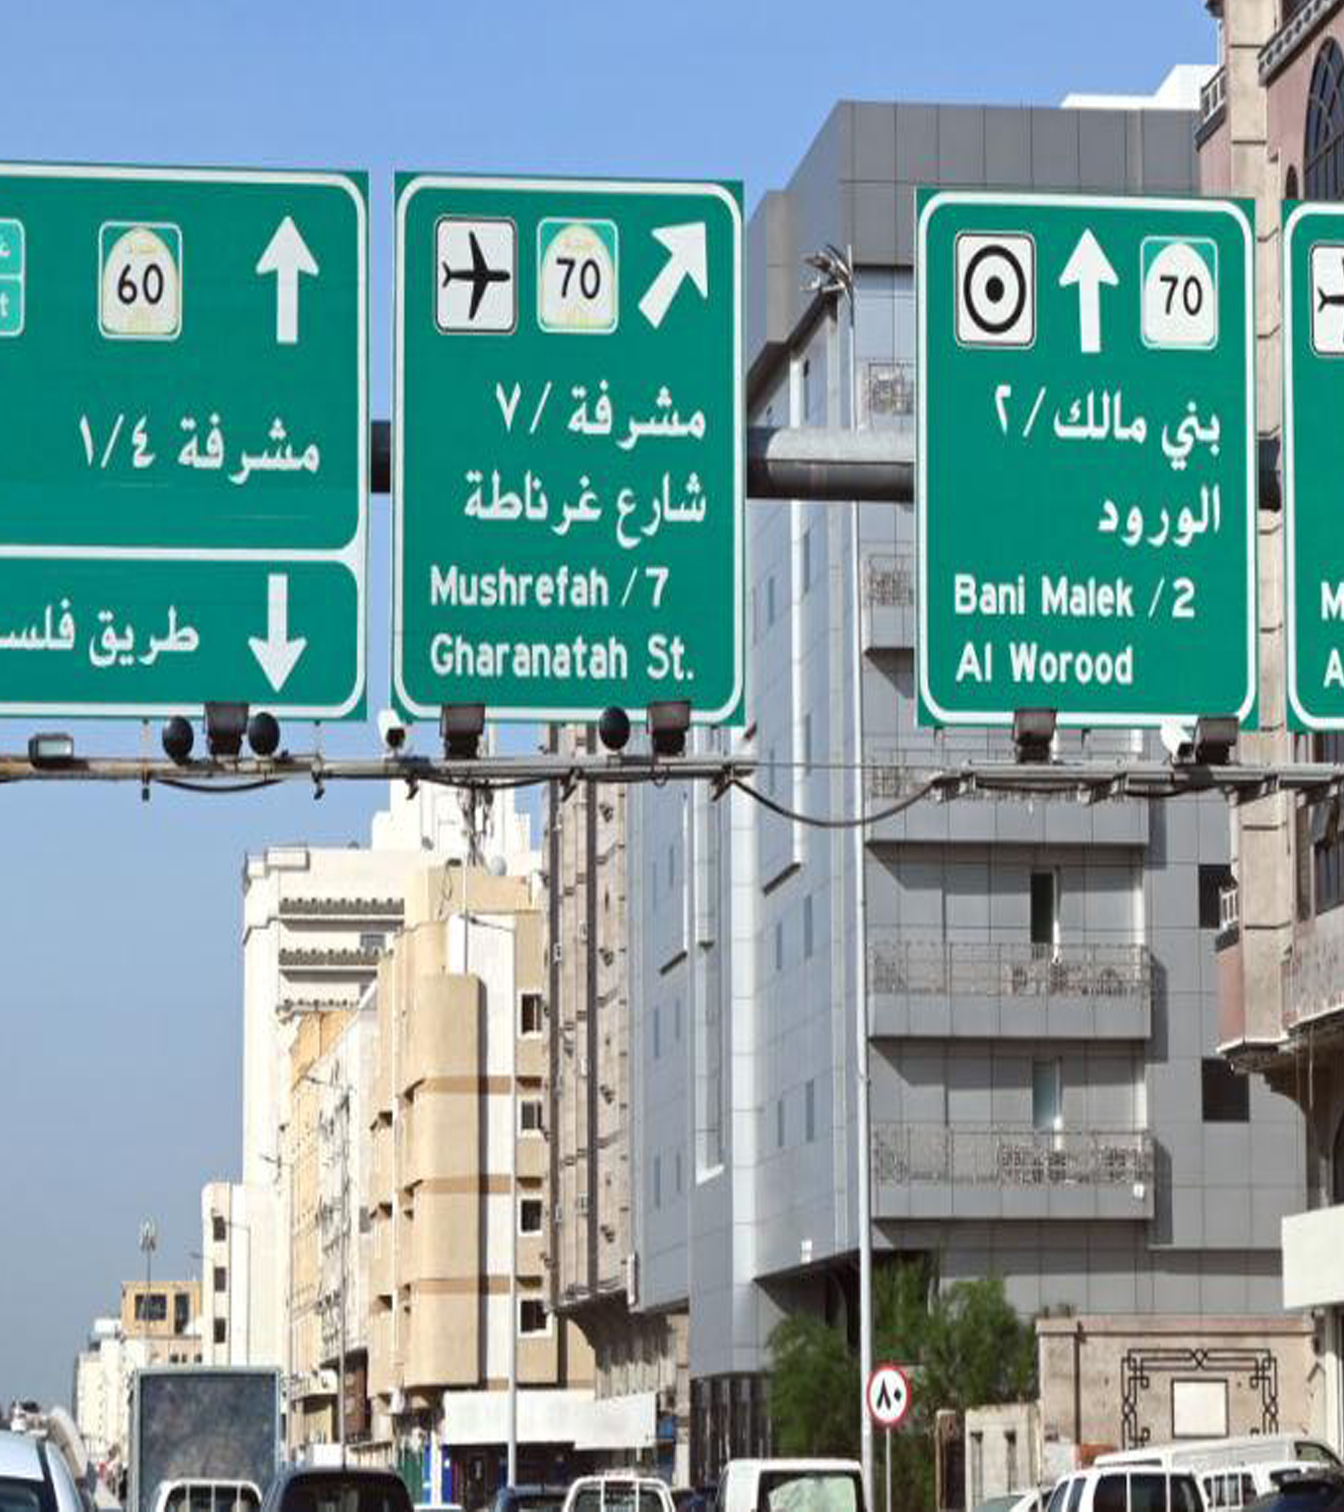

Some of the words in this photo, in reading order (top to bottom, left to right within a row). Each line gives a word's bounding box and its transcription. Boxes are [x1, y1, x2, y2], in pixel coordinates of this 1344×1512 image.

[117, 263, 164, 305] 60
[556, 257, 601, 300] 70
[1159, 275, 1203, 316] 70
[568, 379, 706, 450] مشرفة
[1053, 390, 1148, 443] مالك
[1161, 402, 1221, 471] بني
[178, 413, 320, 484] مشرفة
[464, 469, 602, 535] غرناطة
[616, 472, 706, 549] شارع
[1098, 485, 1221, 547] الورود
[430, 565, 609, 607] Mushrefah
[954, 573, 1026, 615] Bani
[1041, 575, 1134, 617] Malek
[89, 606, 200, 667] طريق
[430, 633, 628, 679] Gharanatah
[647, 634, 694, 681] St.
[955, 642, 992, 682] Al
[1009, 642, 1133, 685] Worood
[876, 1378, 902, 1410] ٨٠
